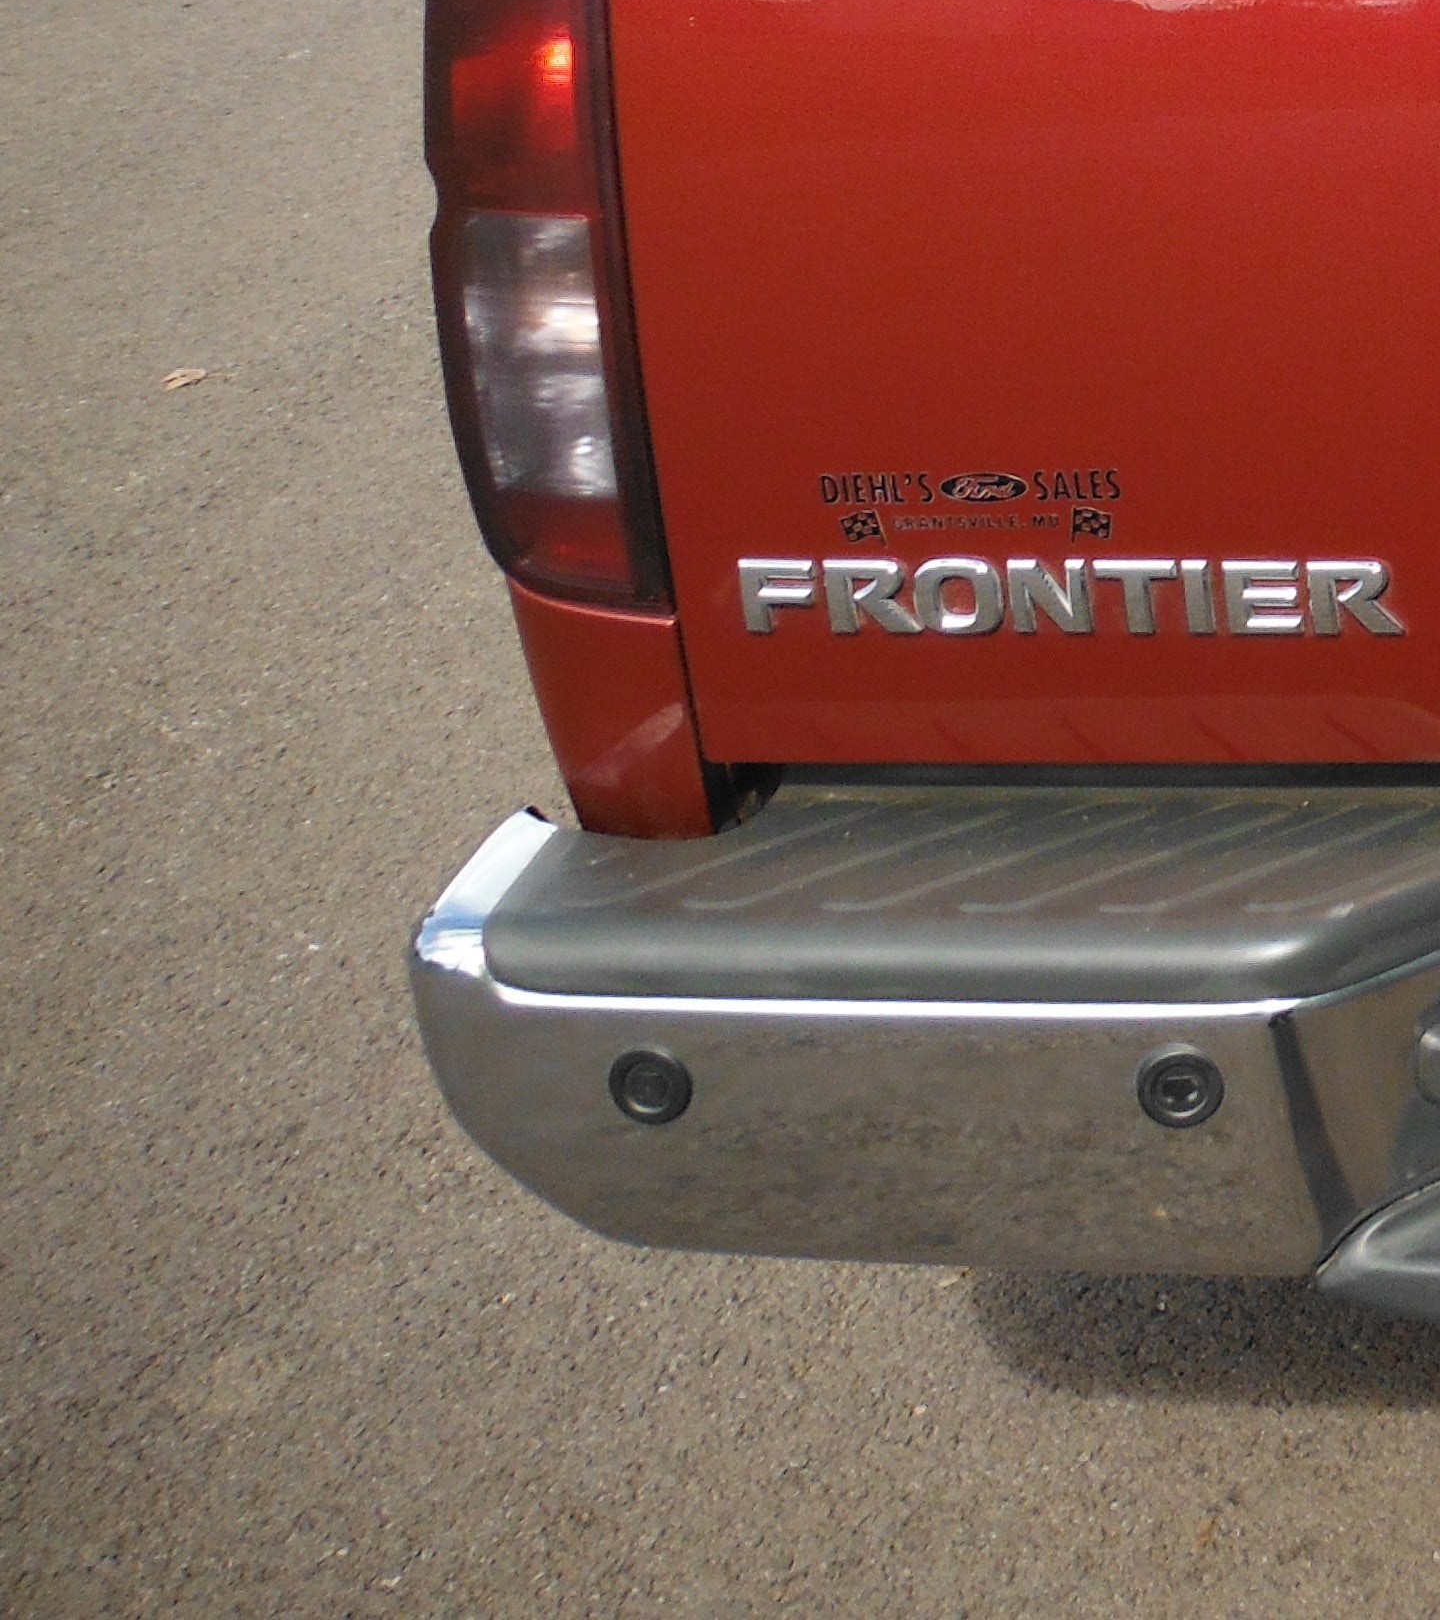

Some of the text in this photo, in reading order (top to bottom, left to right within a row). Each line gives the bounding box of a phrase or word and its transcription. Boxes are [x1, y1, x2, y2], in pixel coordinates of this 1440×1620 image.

[820, 469, 1122, 504] DIEHL'S Ford SALES
[737, 555, 1405, 637] FRONTIER
